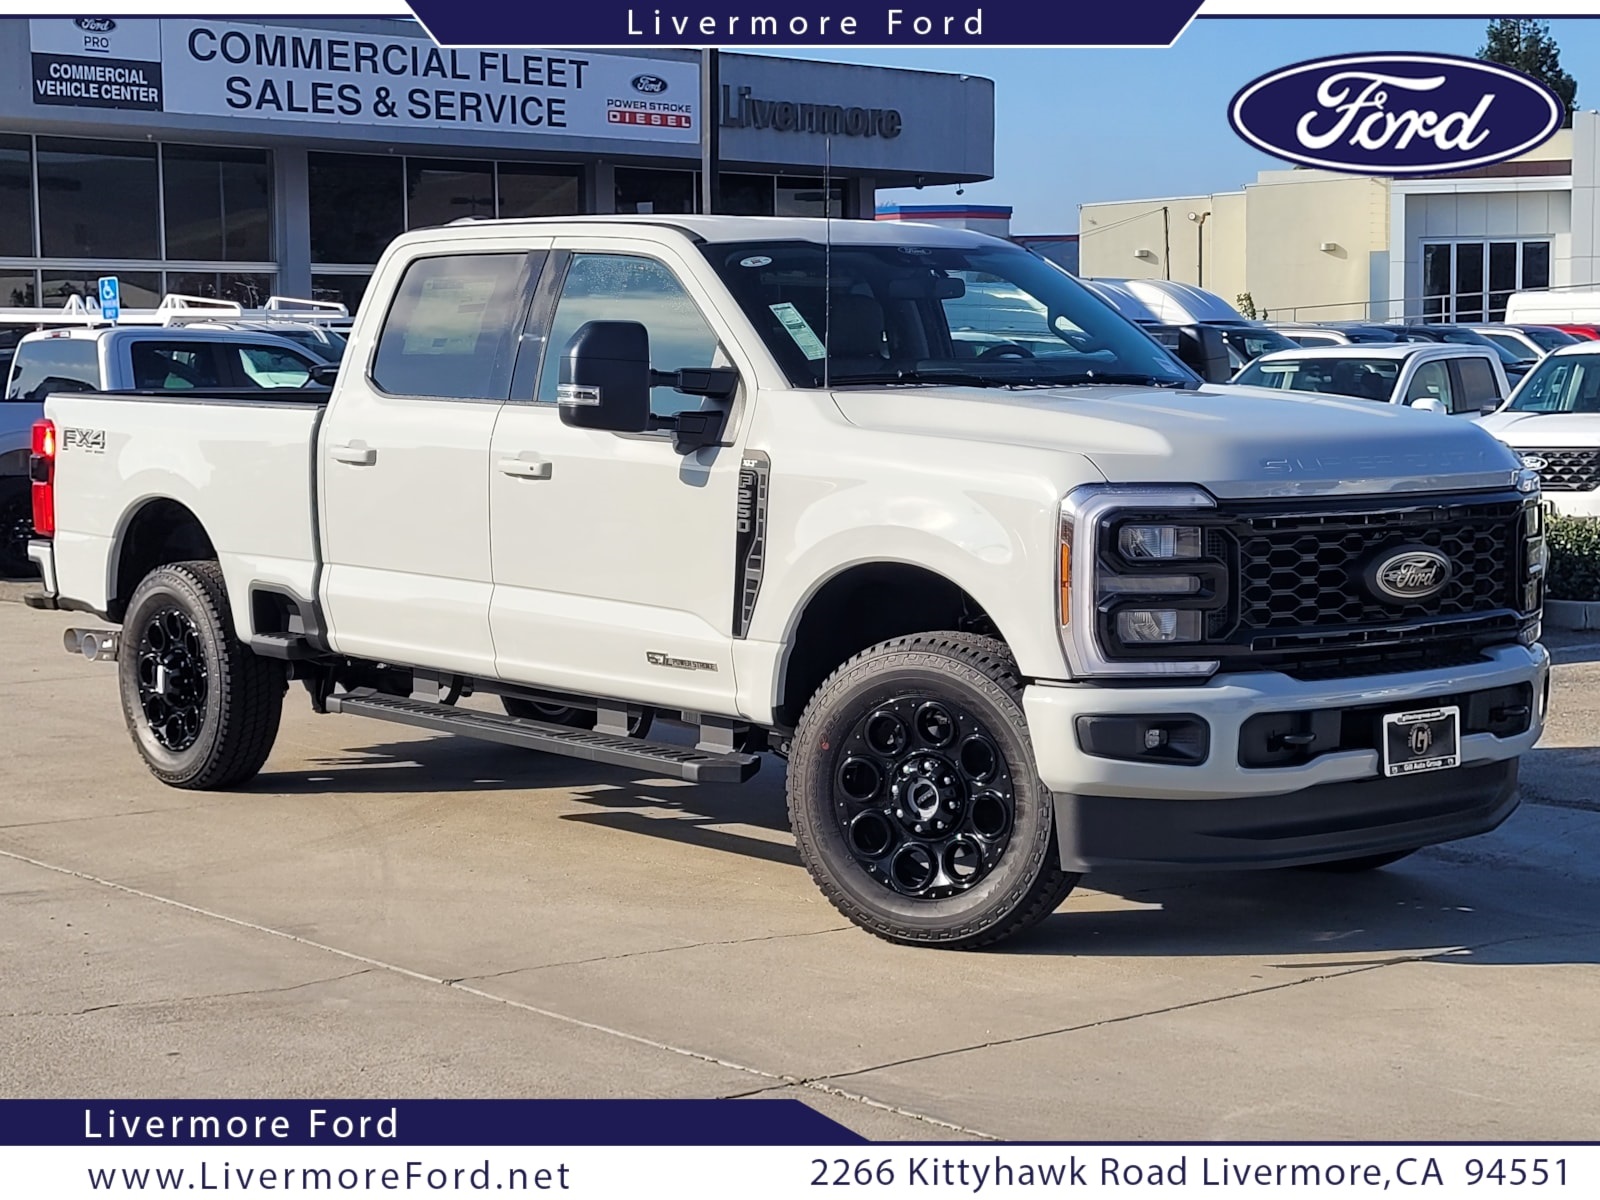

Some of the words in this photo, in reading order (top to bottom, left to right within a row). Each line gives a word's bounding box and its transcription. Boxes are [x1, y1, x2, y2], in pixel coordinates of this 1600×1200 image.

[84, 36, 109, 48] PRO
[188, 28, 470, 80] COMMERCIAL
[479, 51, 589, 89] FLEET
[49, 63, 148, 85] COMMERCIAL
[637, 76, 662, 92] Ford
[36, 80, 99, 98] VEHICLE
[101, 85, 159, 102] CENTER
[225, 76, 362, 116] SALES
[373, 86, 398, 118] &
[407, 88, 567, 128] SERVICE
[607, 99, 647, 110] POWER
[649, 102, 692, 113] STROKE
[720, 84, 902, 139] Livermore
[608, 111, 690, 127] DIESEL
[63, 427, 105, 450] FX4
[1396, 560, 1436, 588] Ford
